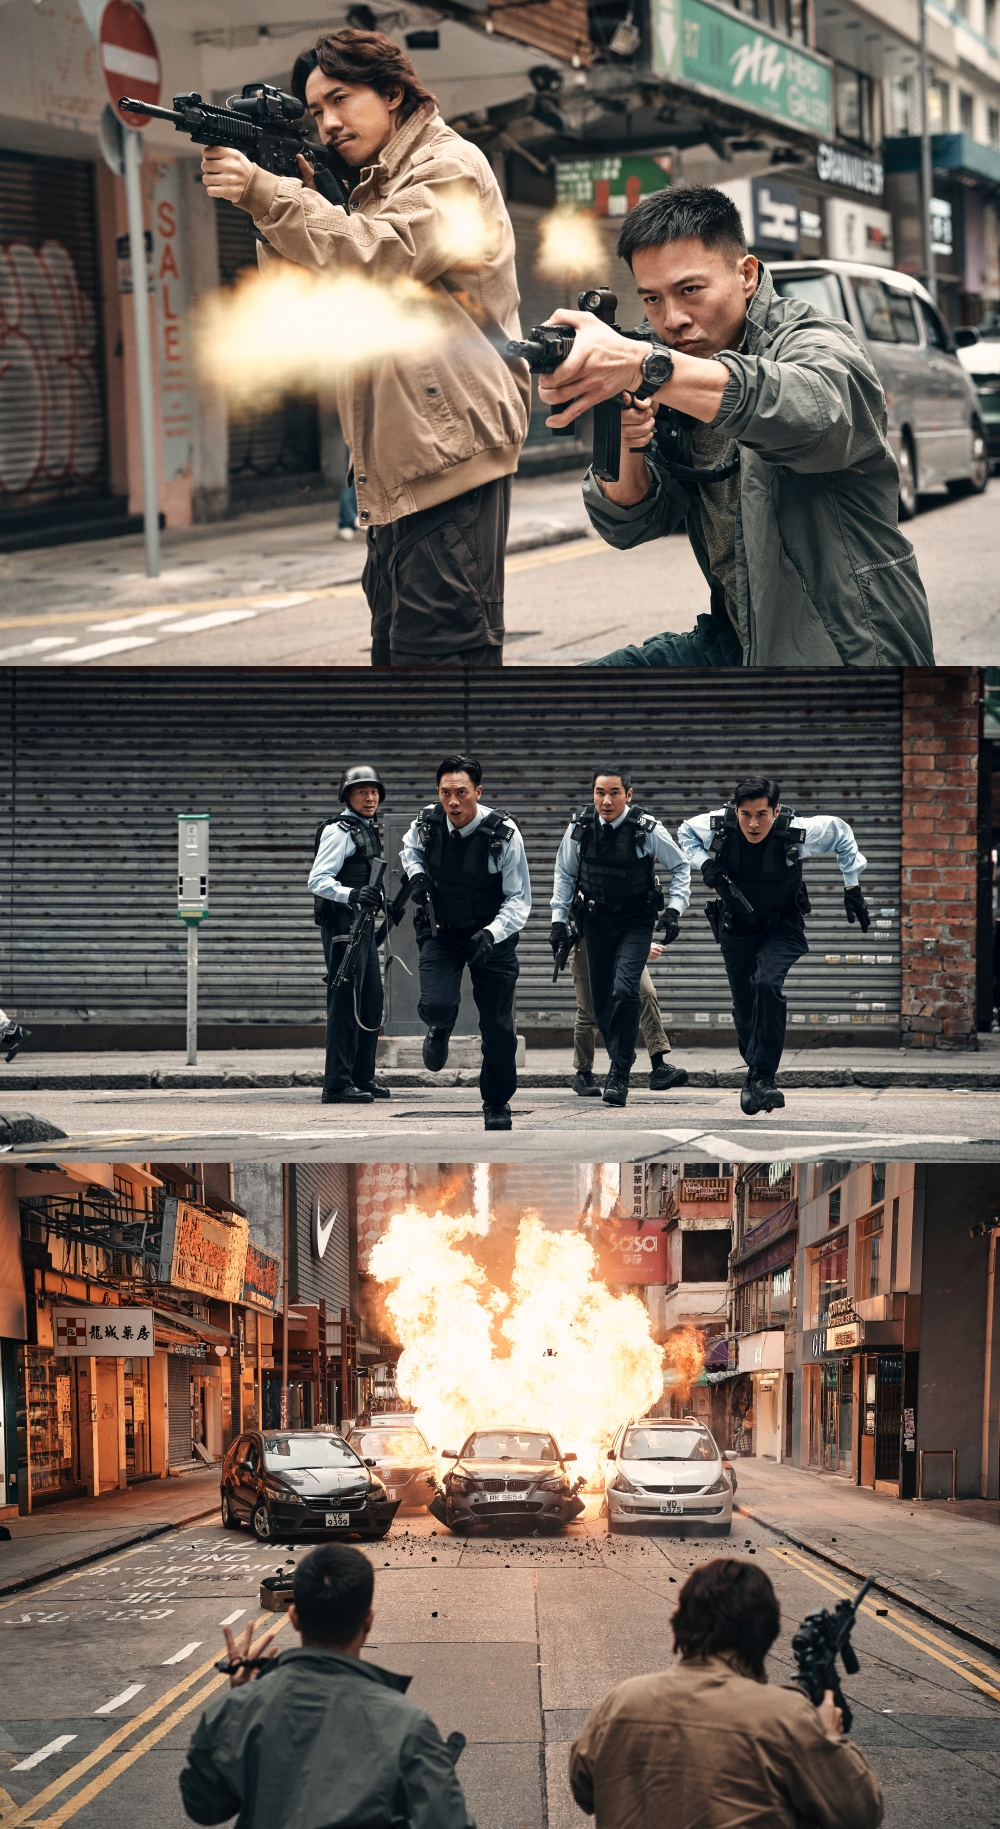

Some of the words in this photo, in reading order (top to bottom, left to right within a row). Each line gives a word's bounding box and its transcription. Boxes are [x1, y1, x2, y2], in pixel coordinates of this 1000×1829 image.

[157, 201, 179, 362] SALE
[88, 1324, 151, 1341] 龍城藥房
[327, 1519, 348, 1527] 9399
